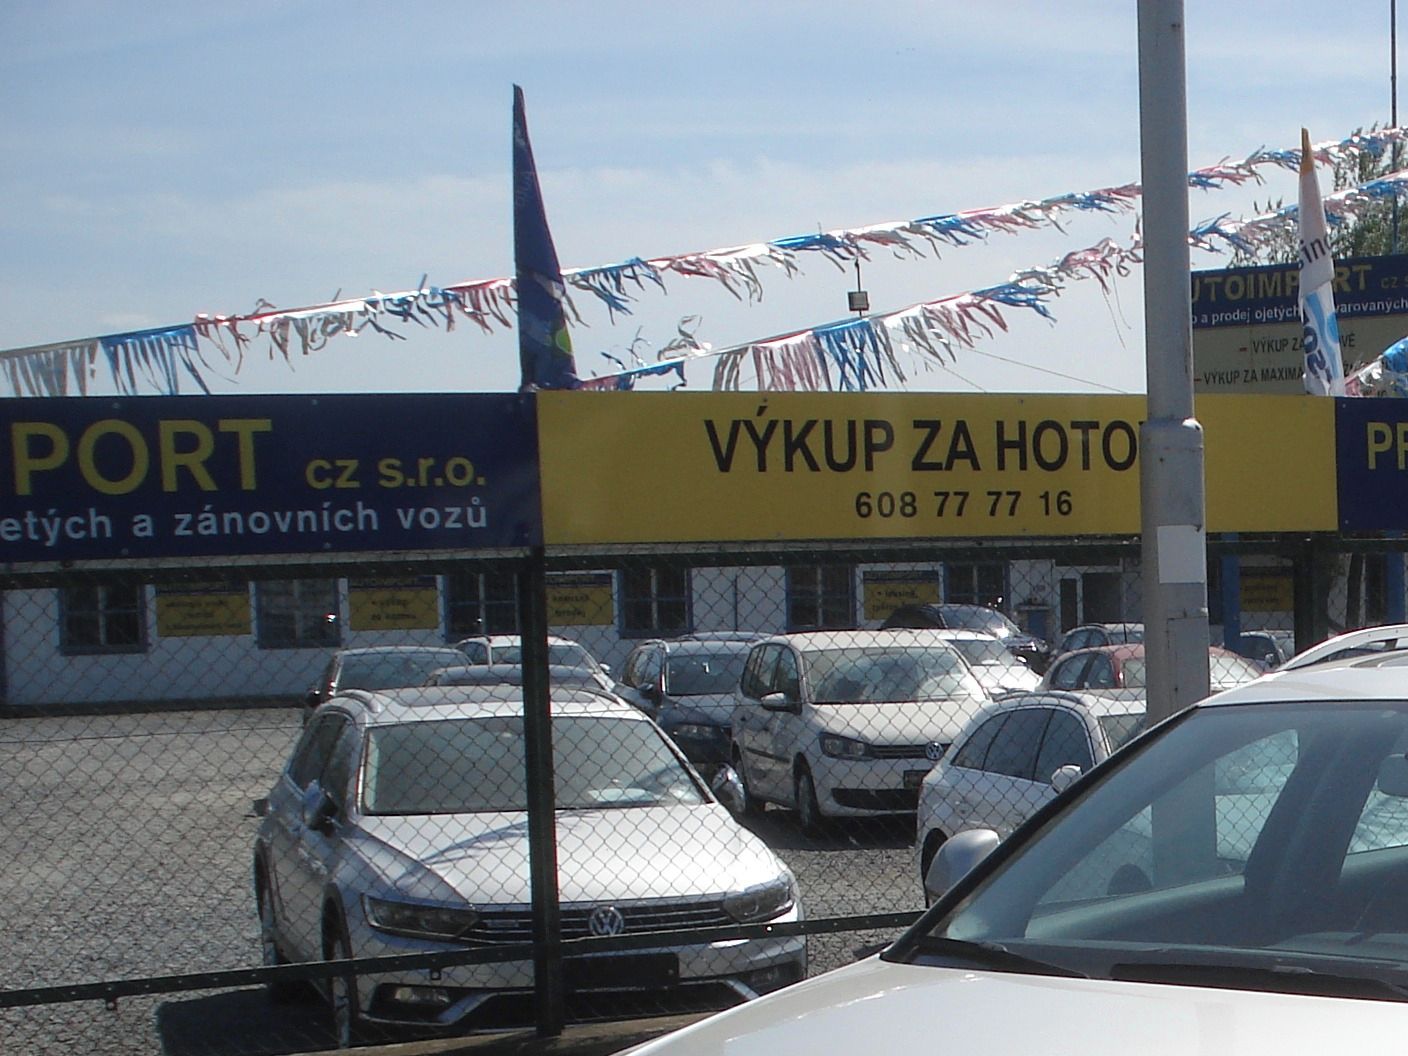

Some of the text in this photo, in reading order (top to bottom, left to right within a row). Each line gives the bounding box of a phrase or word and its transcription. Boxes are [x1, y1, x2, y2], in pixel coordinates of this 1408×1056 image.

[1212, 309, 1250, 325] prodej
[1253, 336, 1288, 352] VÝKUP
[1204, 370, 1240, 385] VÝKUP
[1243, 369, 1258, 383] ZA
[704, 405, 1144, 473] VÝKUP ZA HOTO
[306, 459, 360, 489] cz
[378, 456, 486, 488] s.r.o.
[132, 513, 154, 537] a
[174, 501, 378, 536] zánovních
[397, 496, 487, 530] vozů
[855, 490, 1072, 519] 608 77 77 16
